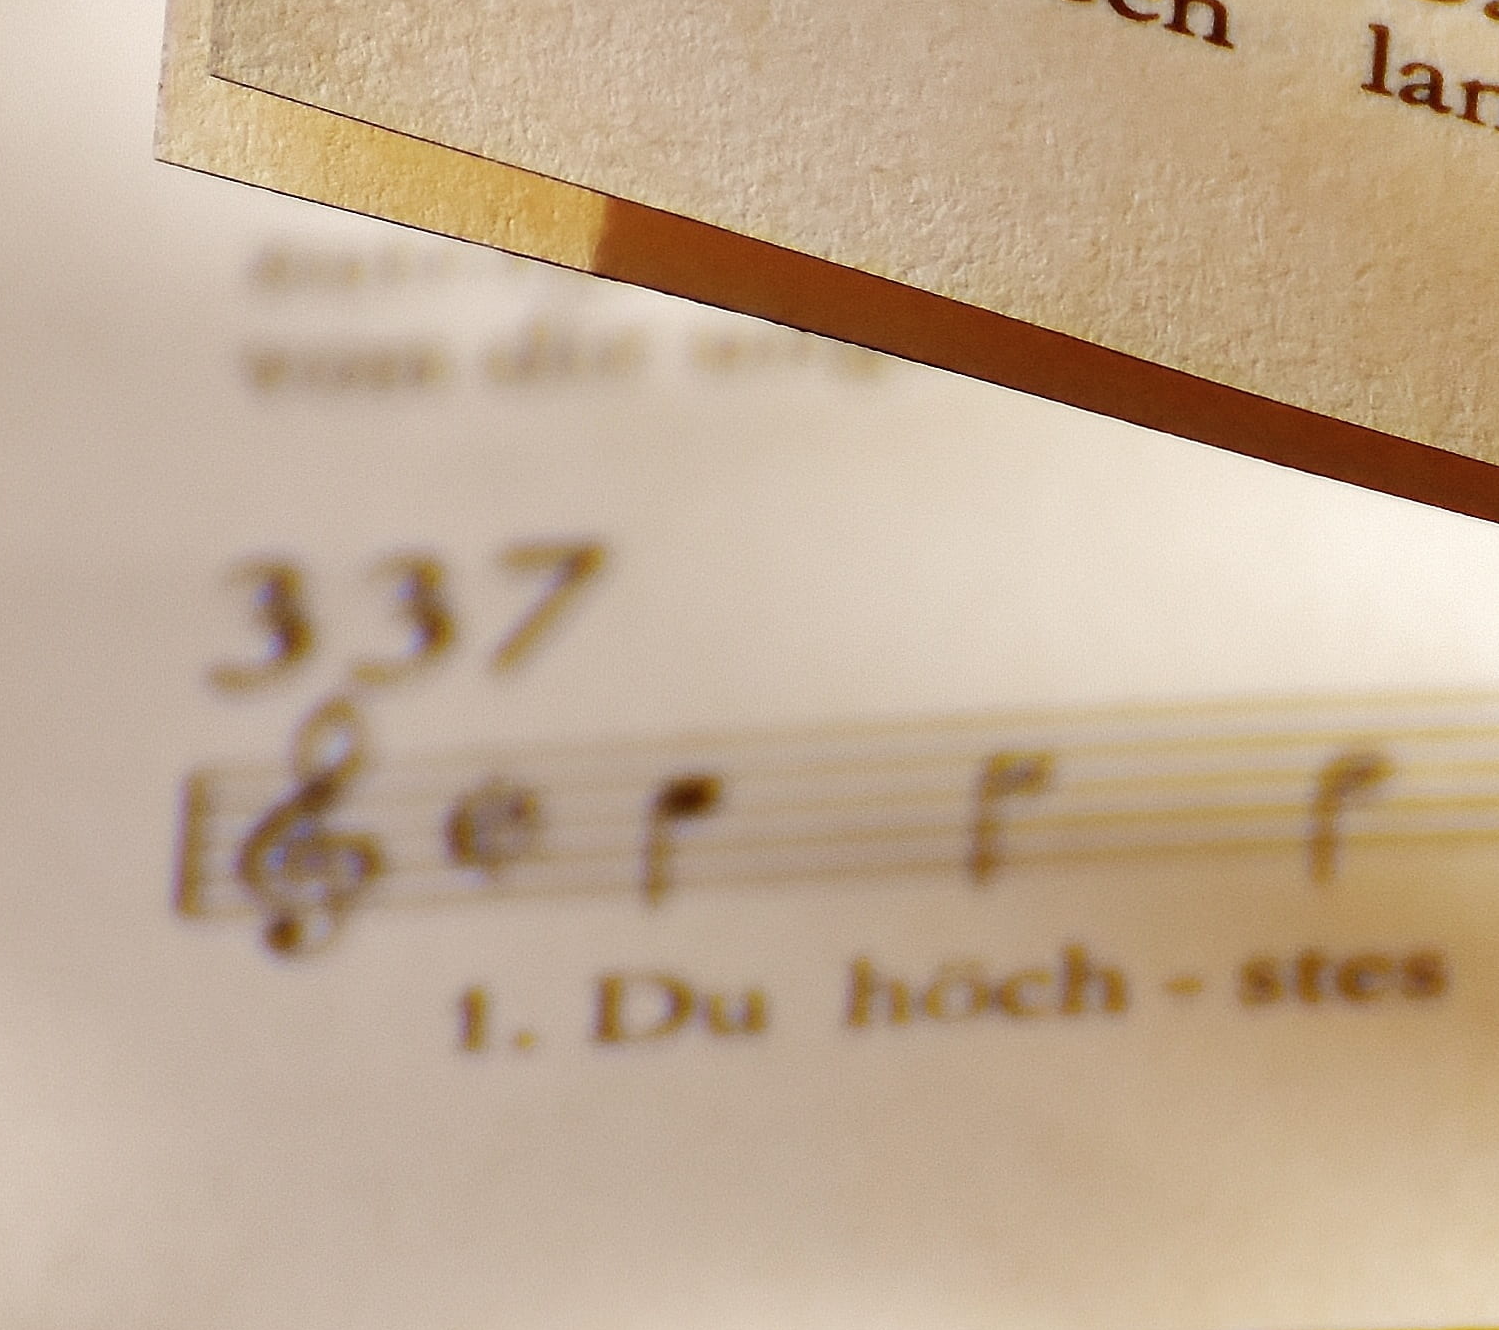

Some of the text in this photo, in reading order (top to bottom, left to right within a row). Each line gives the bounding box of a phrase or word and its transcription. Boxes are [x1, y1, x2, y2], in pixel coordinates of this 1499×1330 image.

[205, 538, 609, 689] 337
[459, 985, 536, 1054] 1.
[592, 968, 770, 1048] Du
